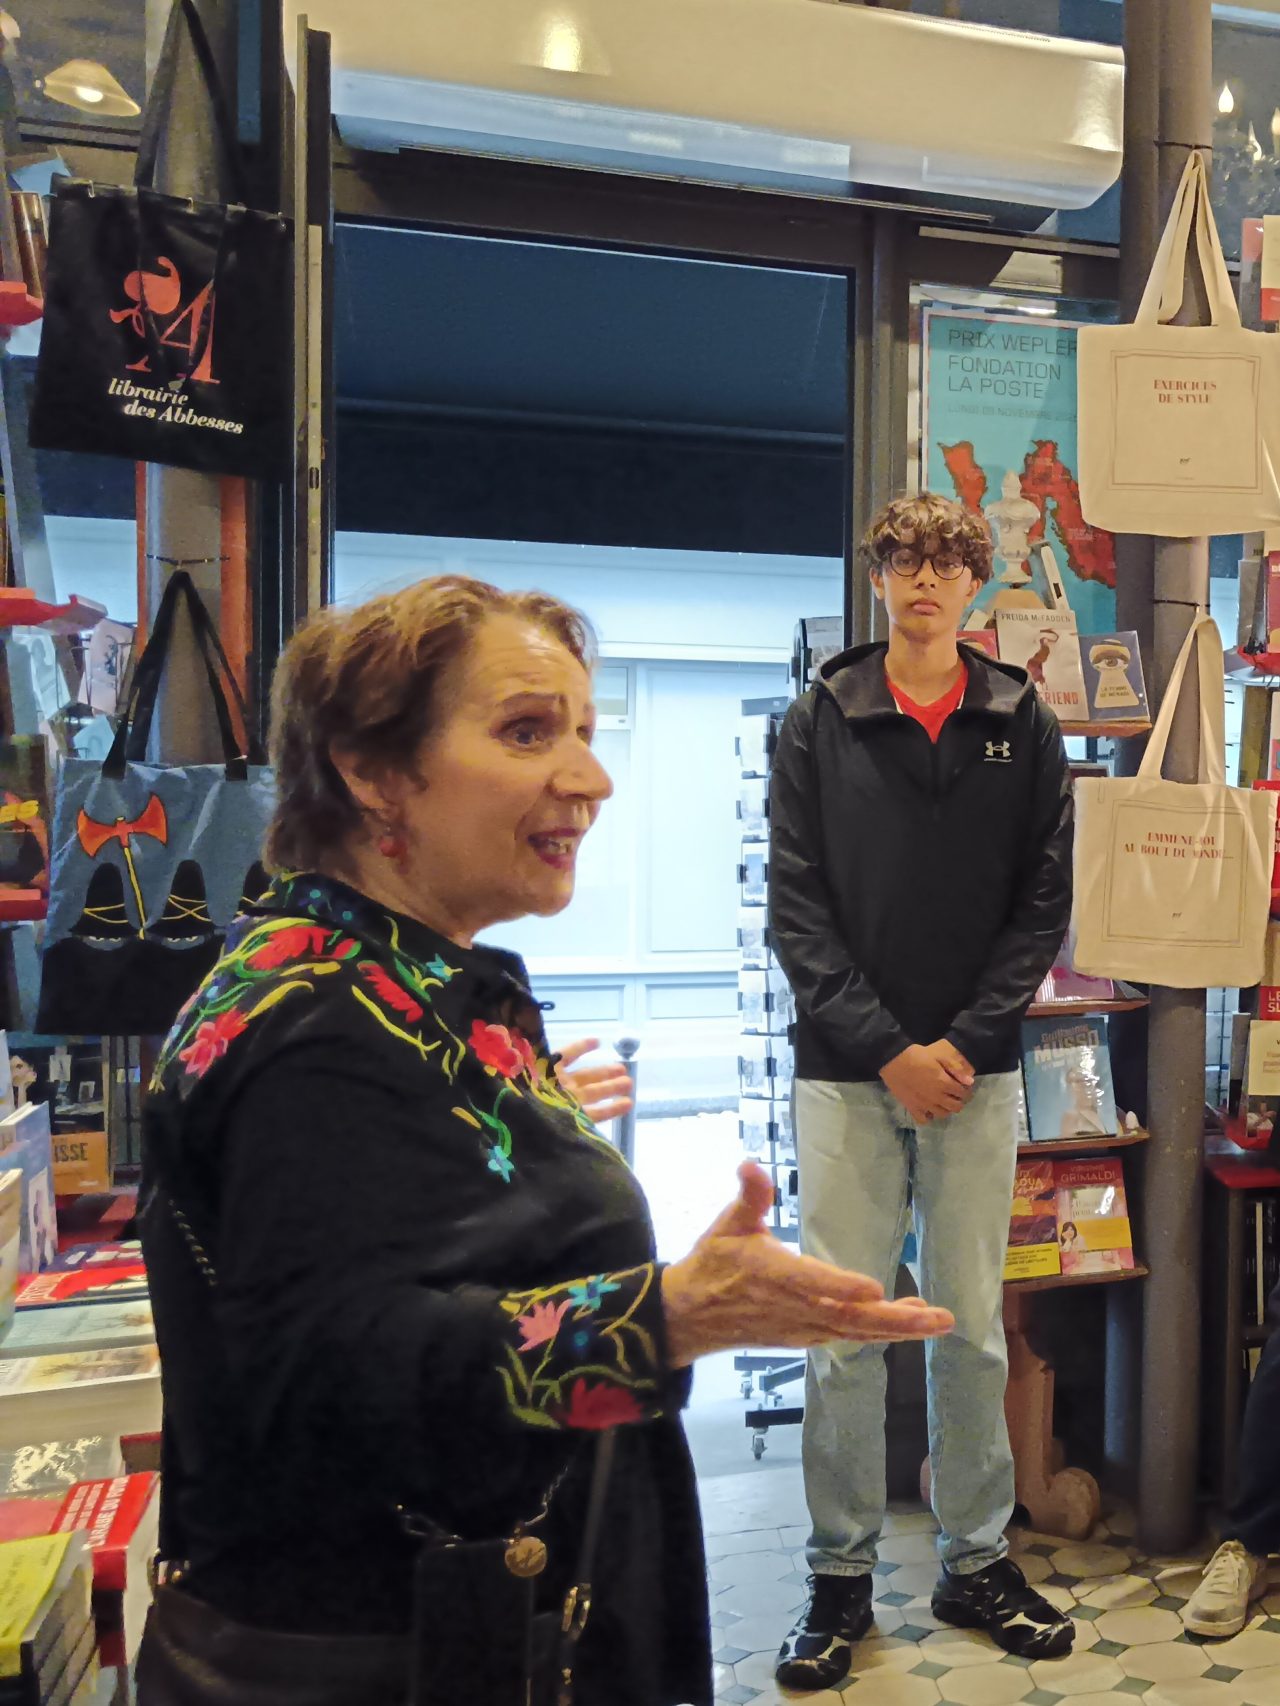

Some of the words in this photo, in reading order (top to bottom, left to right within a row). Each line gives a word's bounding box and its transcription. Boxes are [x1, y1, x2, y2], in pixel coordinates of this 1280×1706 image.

[948, 329, 996, 350] PRIX
[1001, 333, 1077, 356] WEPLER
[948, 354, 1061, 381] FONDATION
[108, 377, 189, 406] librairie
[948, 376, 973, 392] LA
[980, 378, 1045, 399] POSTE
[1153, 379, 1217, 391] EXERCICES
[1158, 393, 1175, 404] DE
[1177, 393, 1211, 404] STYLE
[124, 399, 156, 419] des
[158, 404, 244, 435] Abbesses
[1001, 613, 1029, 622] FREIDA
[1123, 843, 1135, 852] AU
[1140, 845, 1169, 858] BOUT
[1173, 848, 1186, 859] DU
[1033, 1029, 1100, 1066] MUSSO
[53, 1142, 89, 1163] ISSE
[1060, 1170, 1116, 1183] GRIMALDI
